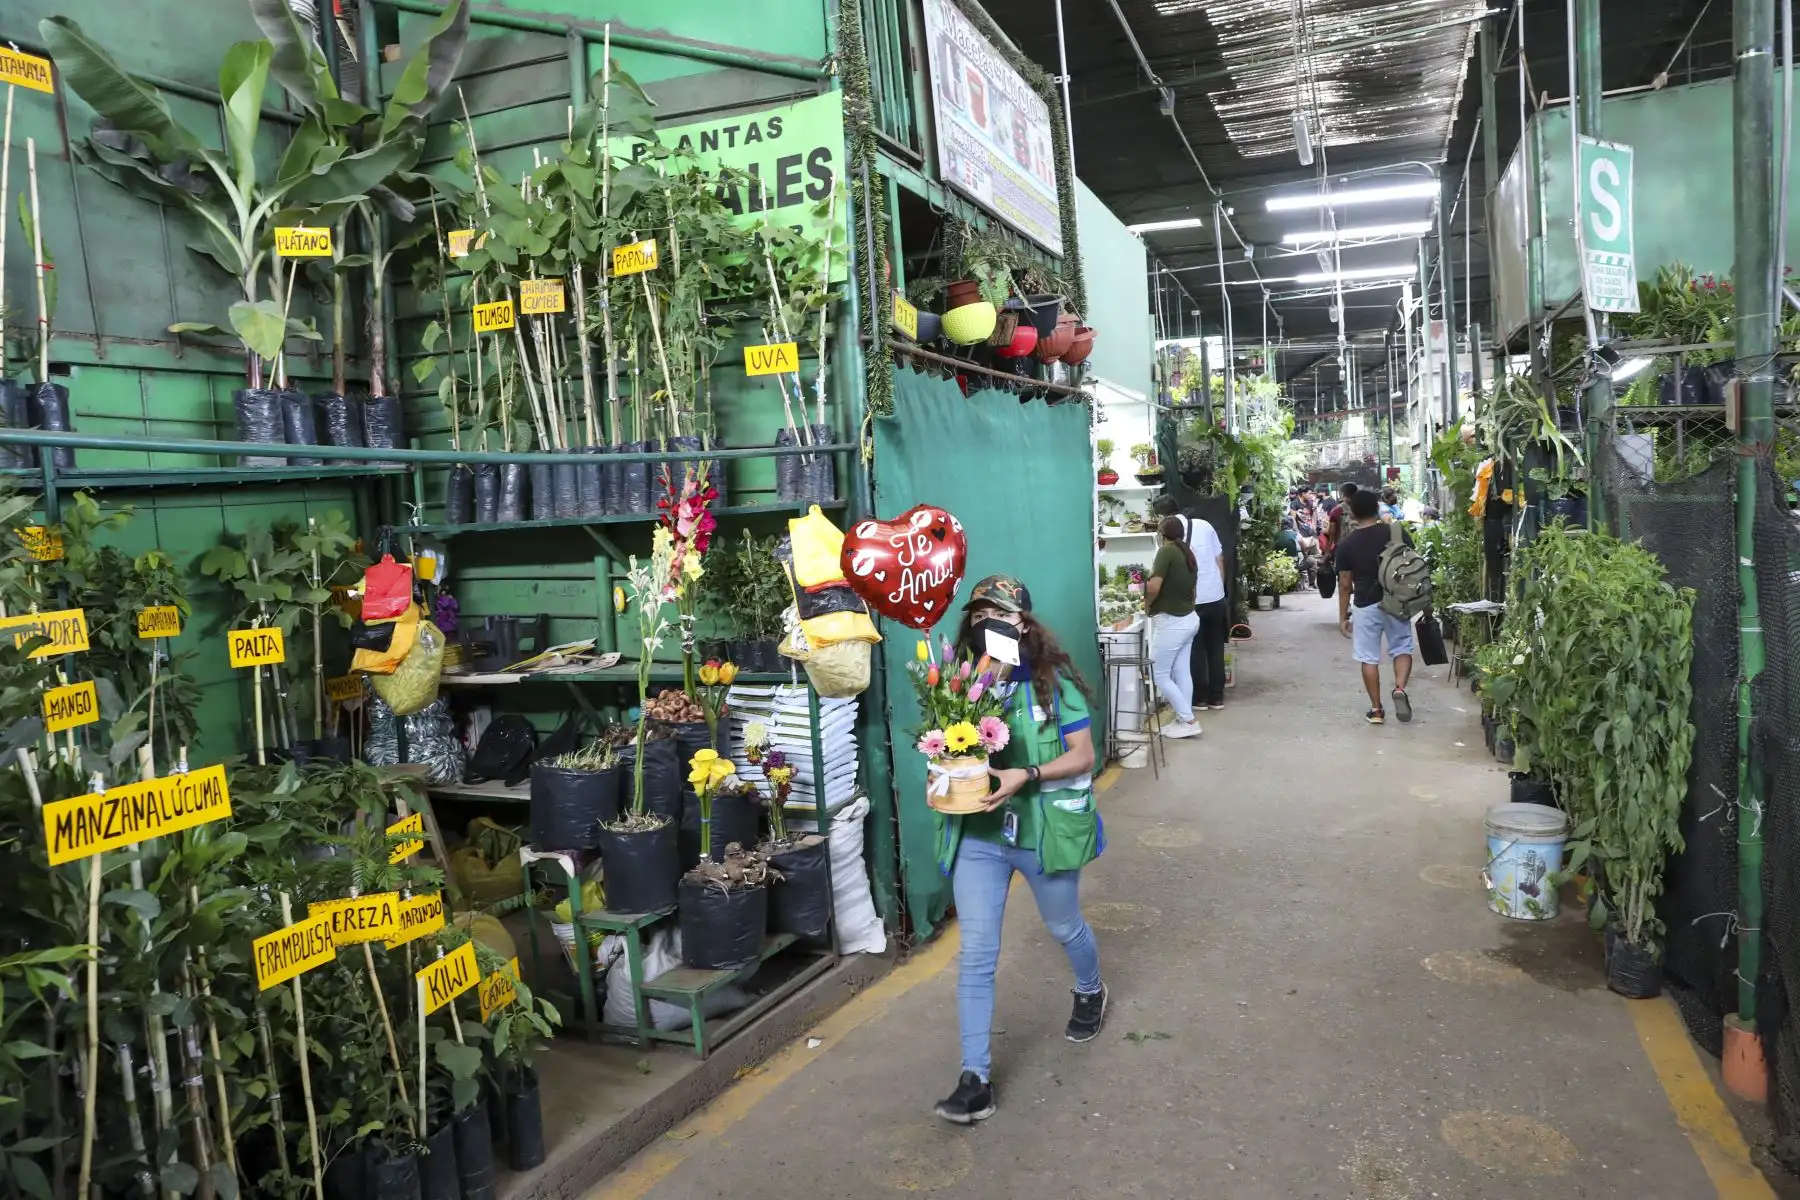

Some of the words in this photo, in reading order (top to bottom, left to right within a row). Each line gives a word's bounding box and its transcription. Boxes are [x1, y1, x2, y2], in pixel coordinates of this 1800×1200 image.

[0, 54, 49, 85] ITAHAYA
[632, 116, 784, 162] PANTAS
[1589, 157, 1621, 242] S
[277, 231, 329, 252] PLÁTANO
[615, 250, 655, 271] PAPAYA
[476, 305, 510, 326] TUMBO
[524, 294, 559, 310] CUMBE
[751, 346, 789, 371] UVA
[890, 529, 932, 567] Te
[888, 547, 955, 604] Amo!
[235, 636, 280, 659] PALTA
[49, 692, 92, 722] MANGO
[332, 902, 393, 934] EREZA
[399, 899, 443, 931] MARINDO
[258, 920, 334, 980] FRAMBUESA
[428, 962, 468, 1007] KIWI
